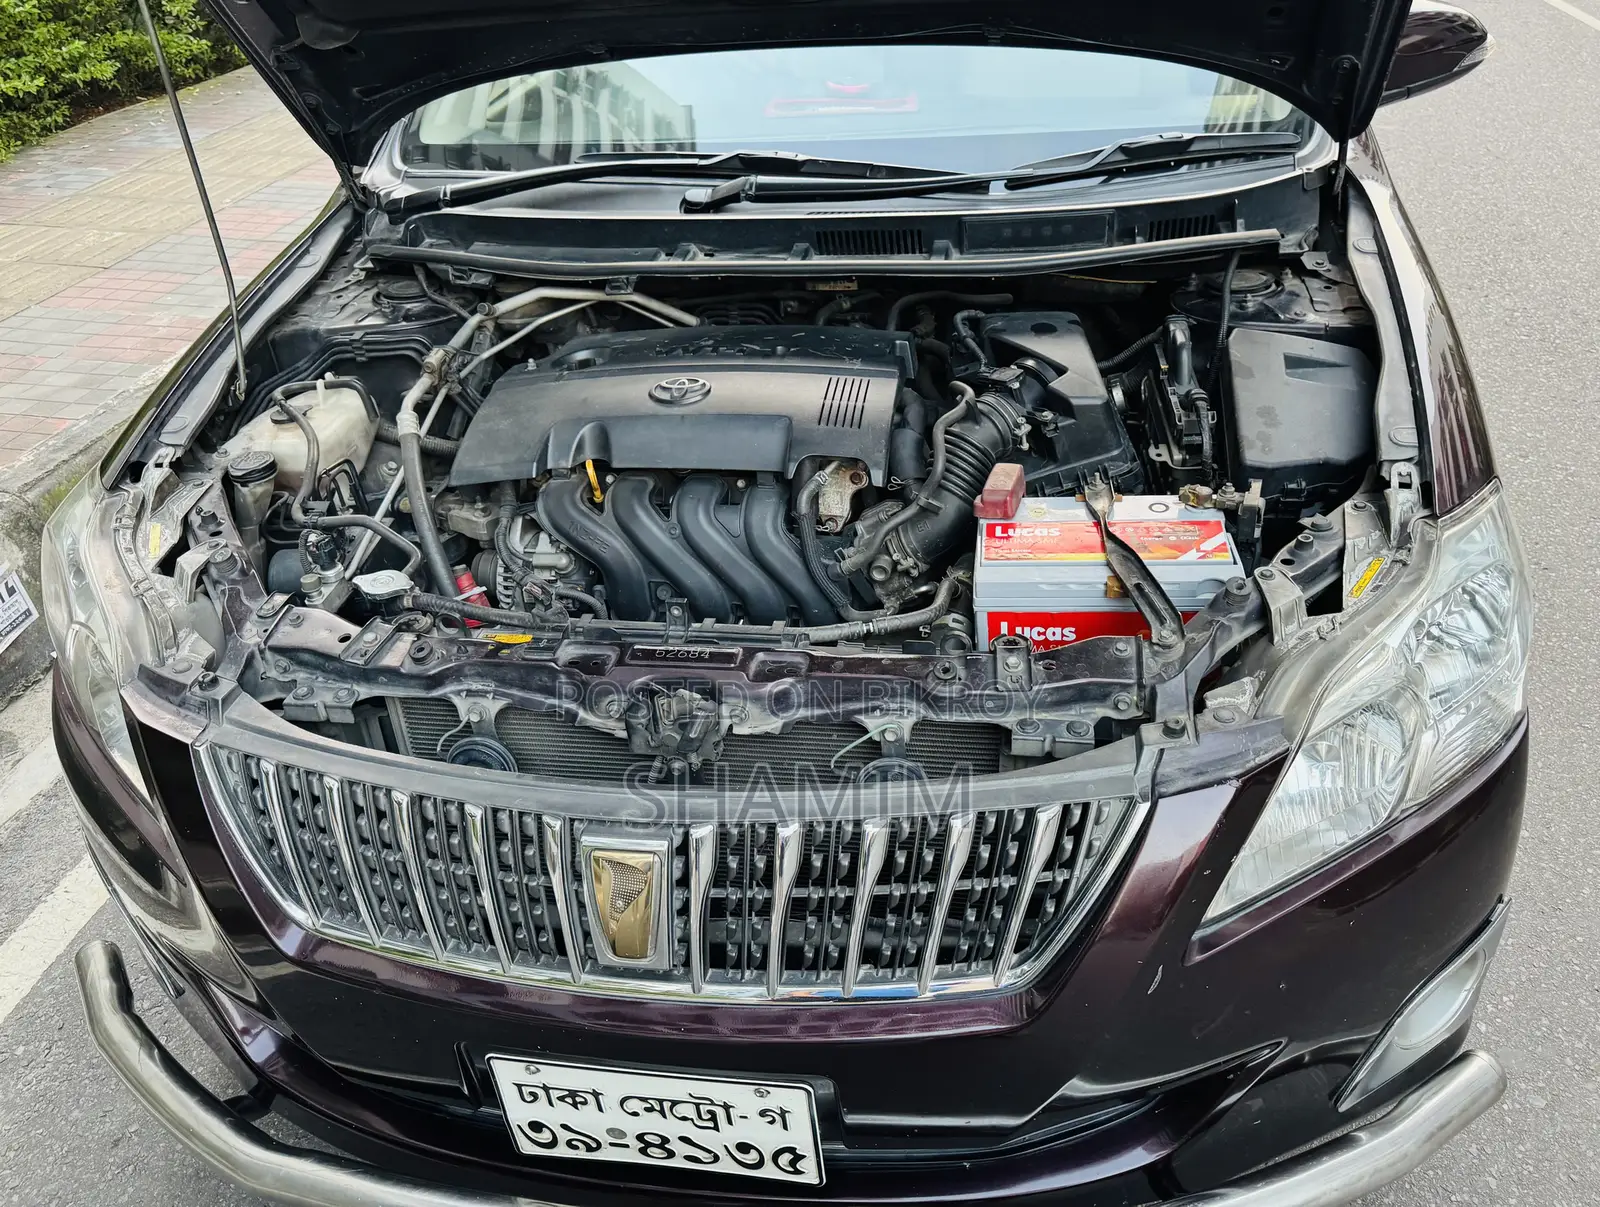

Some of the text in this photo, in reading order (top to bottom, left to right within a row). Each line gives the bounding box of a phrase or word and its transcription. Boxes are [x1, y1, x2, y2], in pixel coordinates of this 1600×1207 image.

[995, 525, 1061, 537] Lucas
[1000, 621, 1077, 641] Lucas
[512, 1082, 604, 1113] ঢাকা
[516, 1119, 808, 1175] ৩৯-৪১৩৫
